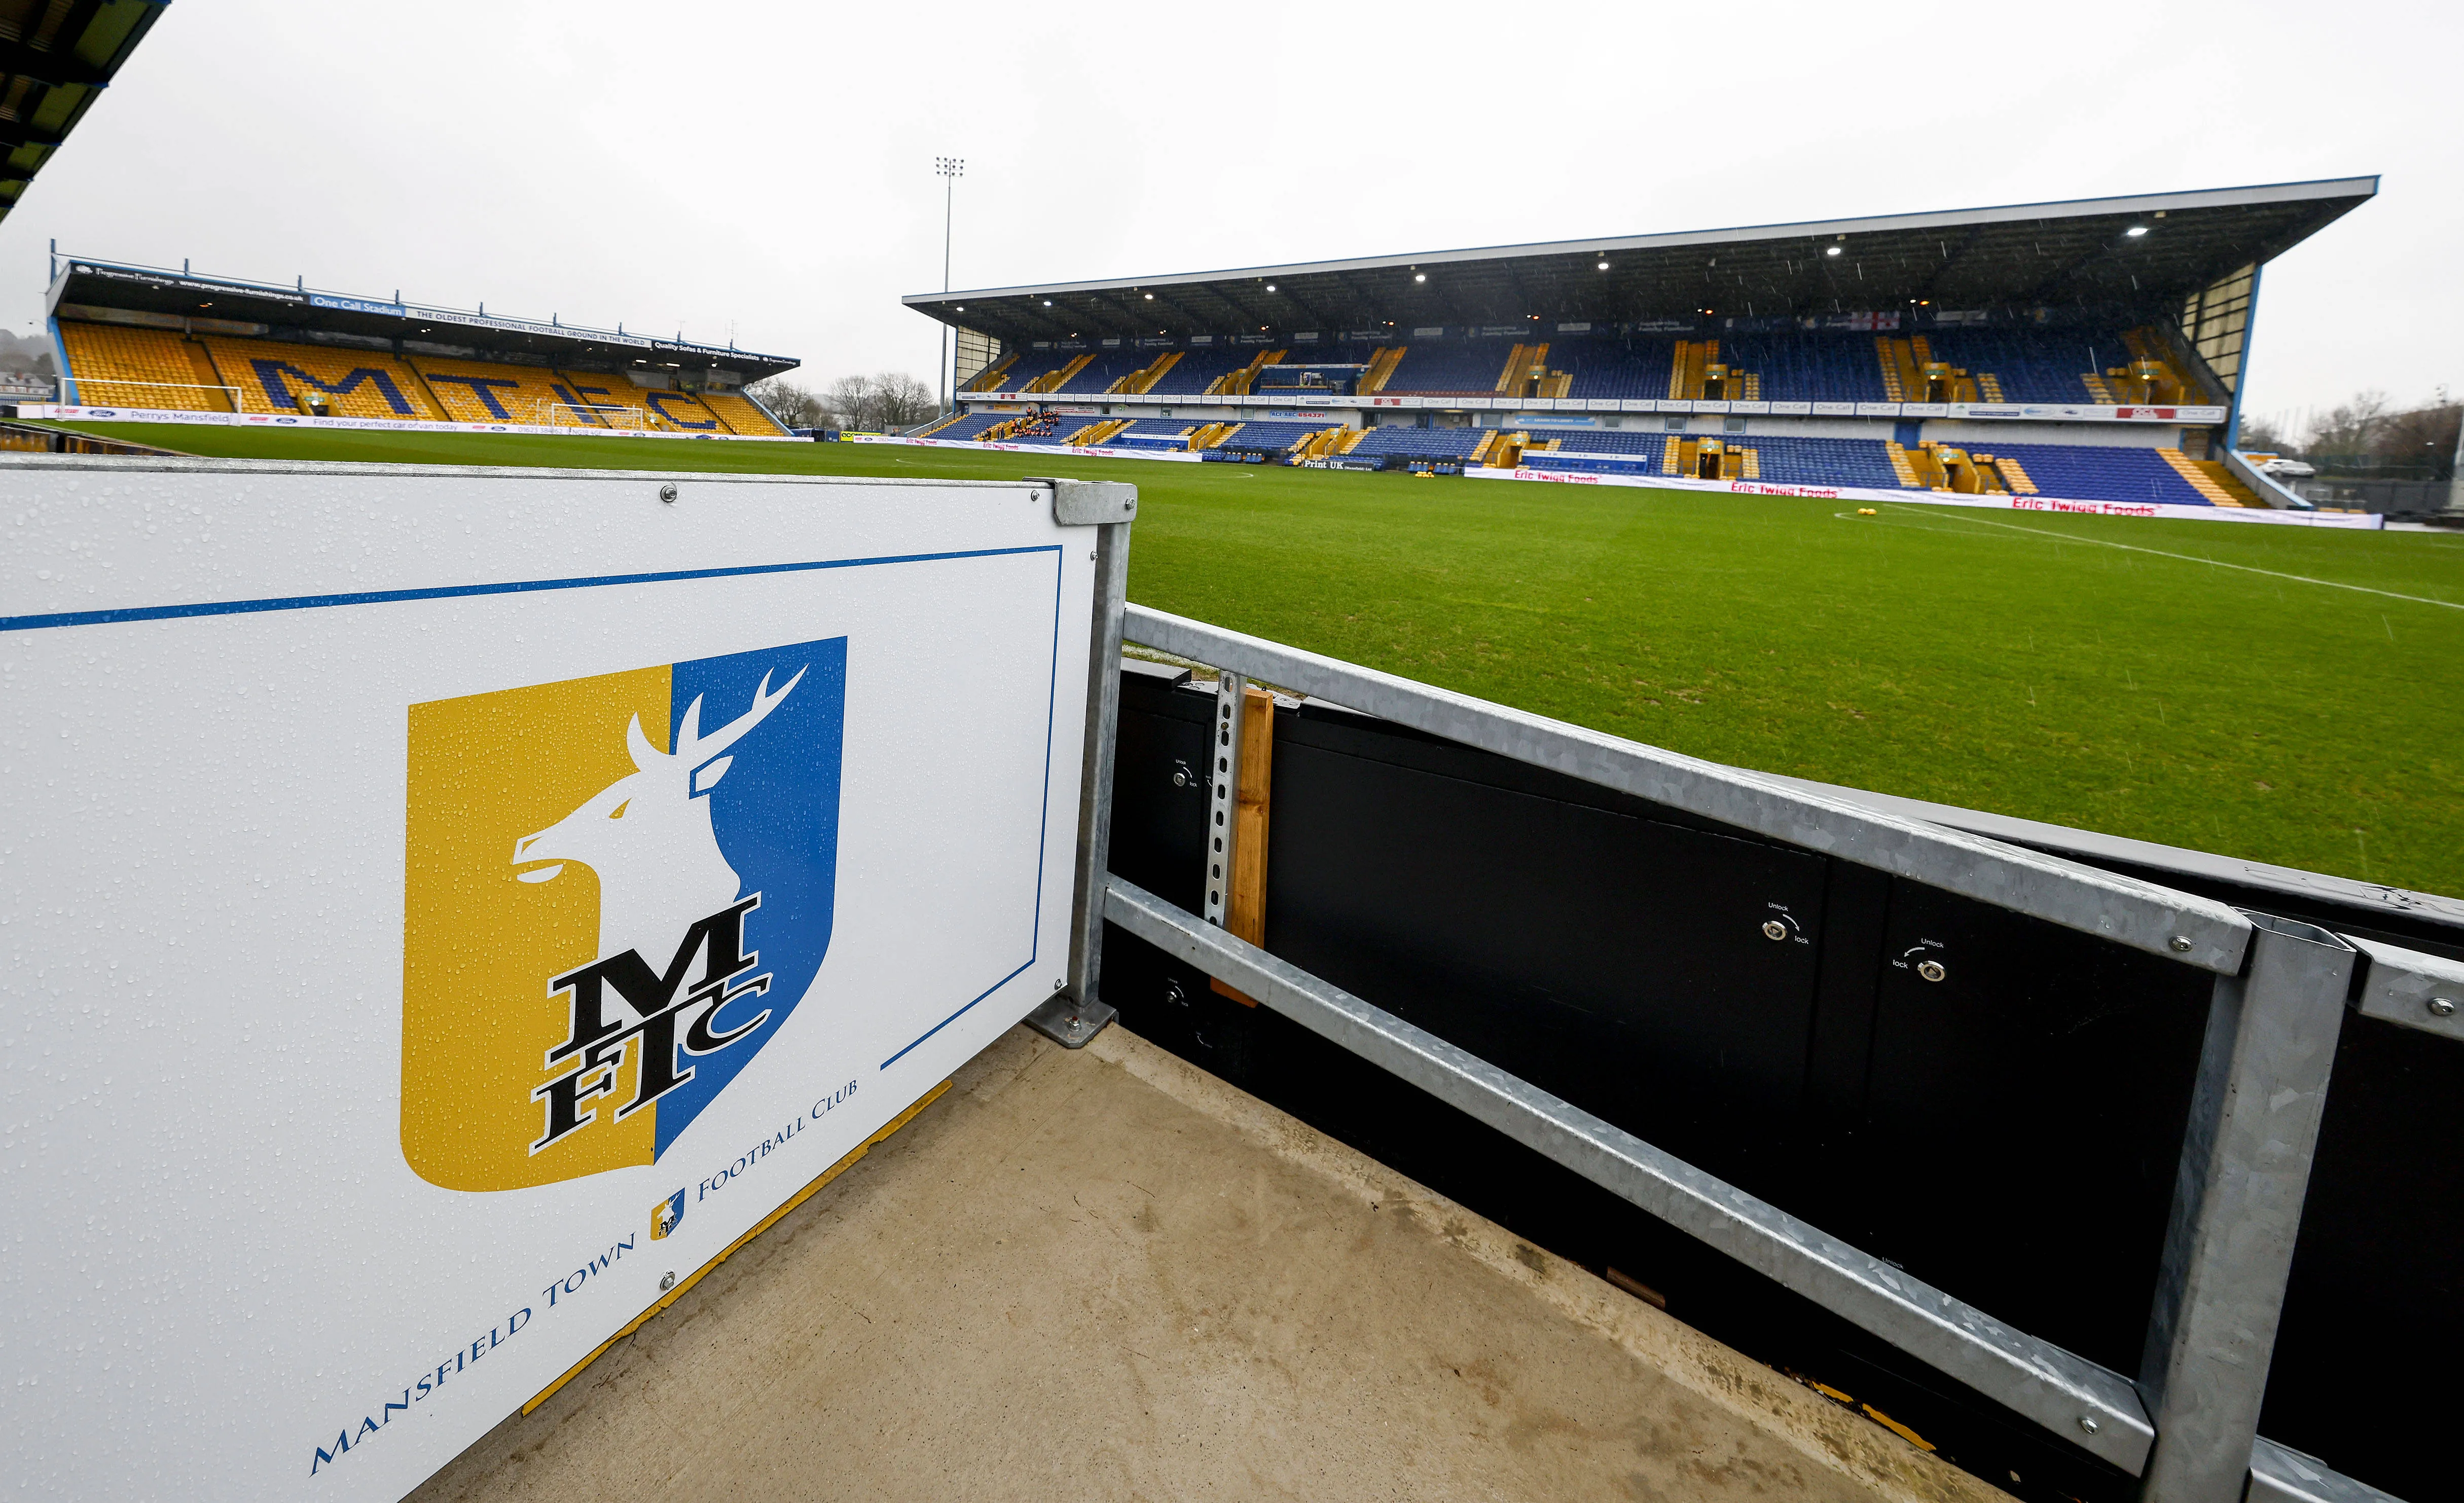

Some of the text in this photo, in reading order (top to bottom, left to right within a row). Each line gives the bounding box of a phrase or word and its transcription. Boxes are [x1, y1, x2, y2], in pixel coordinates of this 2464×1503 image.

[314, 297, 402, 316] One Call Stadium
[436, 313, 466, 323] OLDEST
[469, 318, 526, 331] PROFESSIONAL
[529, 325, 564, 336] FOOTBALL
[567, 331, 597, 340] GROUND
[622, 338, 645, 346] WORLD
[655, 342, 678, 351] Quality
[702, 348, 730, 357] Furniture
[730, 352, 759, 361] Specialists
[131, 411, 229, 422] Perrys Mansfield
[436, 424, 458, 432] today
[1083, 448, 1097, 456] Twigg
[1304, 460, 1327, 468] Print
[1330, 461, 1344, 469] UK
[1514, 470, 1533, 480] Eric
[1569, 474, 1598, 484] Foods
[1731, 481, 1754, 492] Eric
[1800, 488, 1837, 498] Foods
[2013, 497, 2043, 510] Eric
[2104, 504, 2154, 516] Foods
[1768, 902, 1789, 912] Unlock
[1795, 935, 1809, 944] lock
[1921, 938, 1944, 948] Unlock
[1893, 959, 1908, 969] lock
[309, 1079, 858, 1478] MANSFIELD TOWN FOOTBALL CLUB
